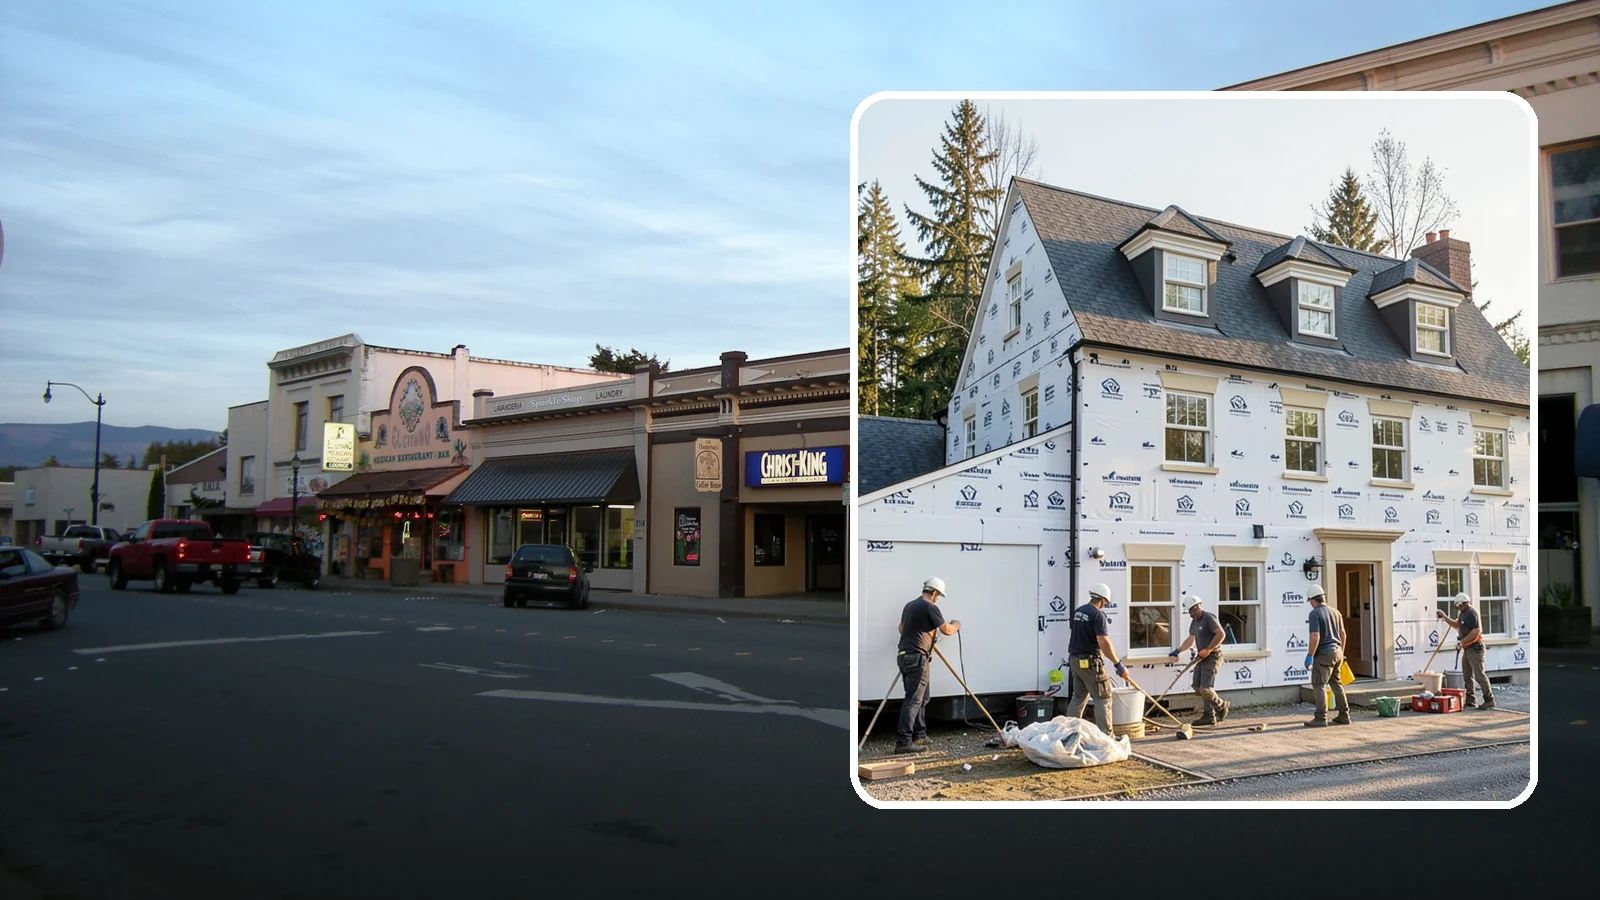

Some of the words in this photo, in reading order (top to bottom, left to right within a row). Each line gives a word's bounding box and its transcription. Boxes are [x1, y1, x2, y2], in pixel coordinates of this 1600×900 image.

[562, 394, 583, 405] Shop
[595, 389, 623, 400] LAUNDRY
[493, 402, 522, 413] LAVANDERIA
[373, 454, 396, 464] MEXICAN
[397, 451, 433, 462] RESTAURANT
[438, 450, 450, 459] BAR
[760, 452, 797, 478] CHRIST
[799, 450, 827, 476] KING
